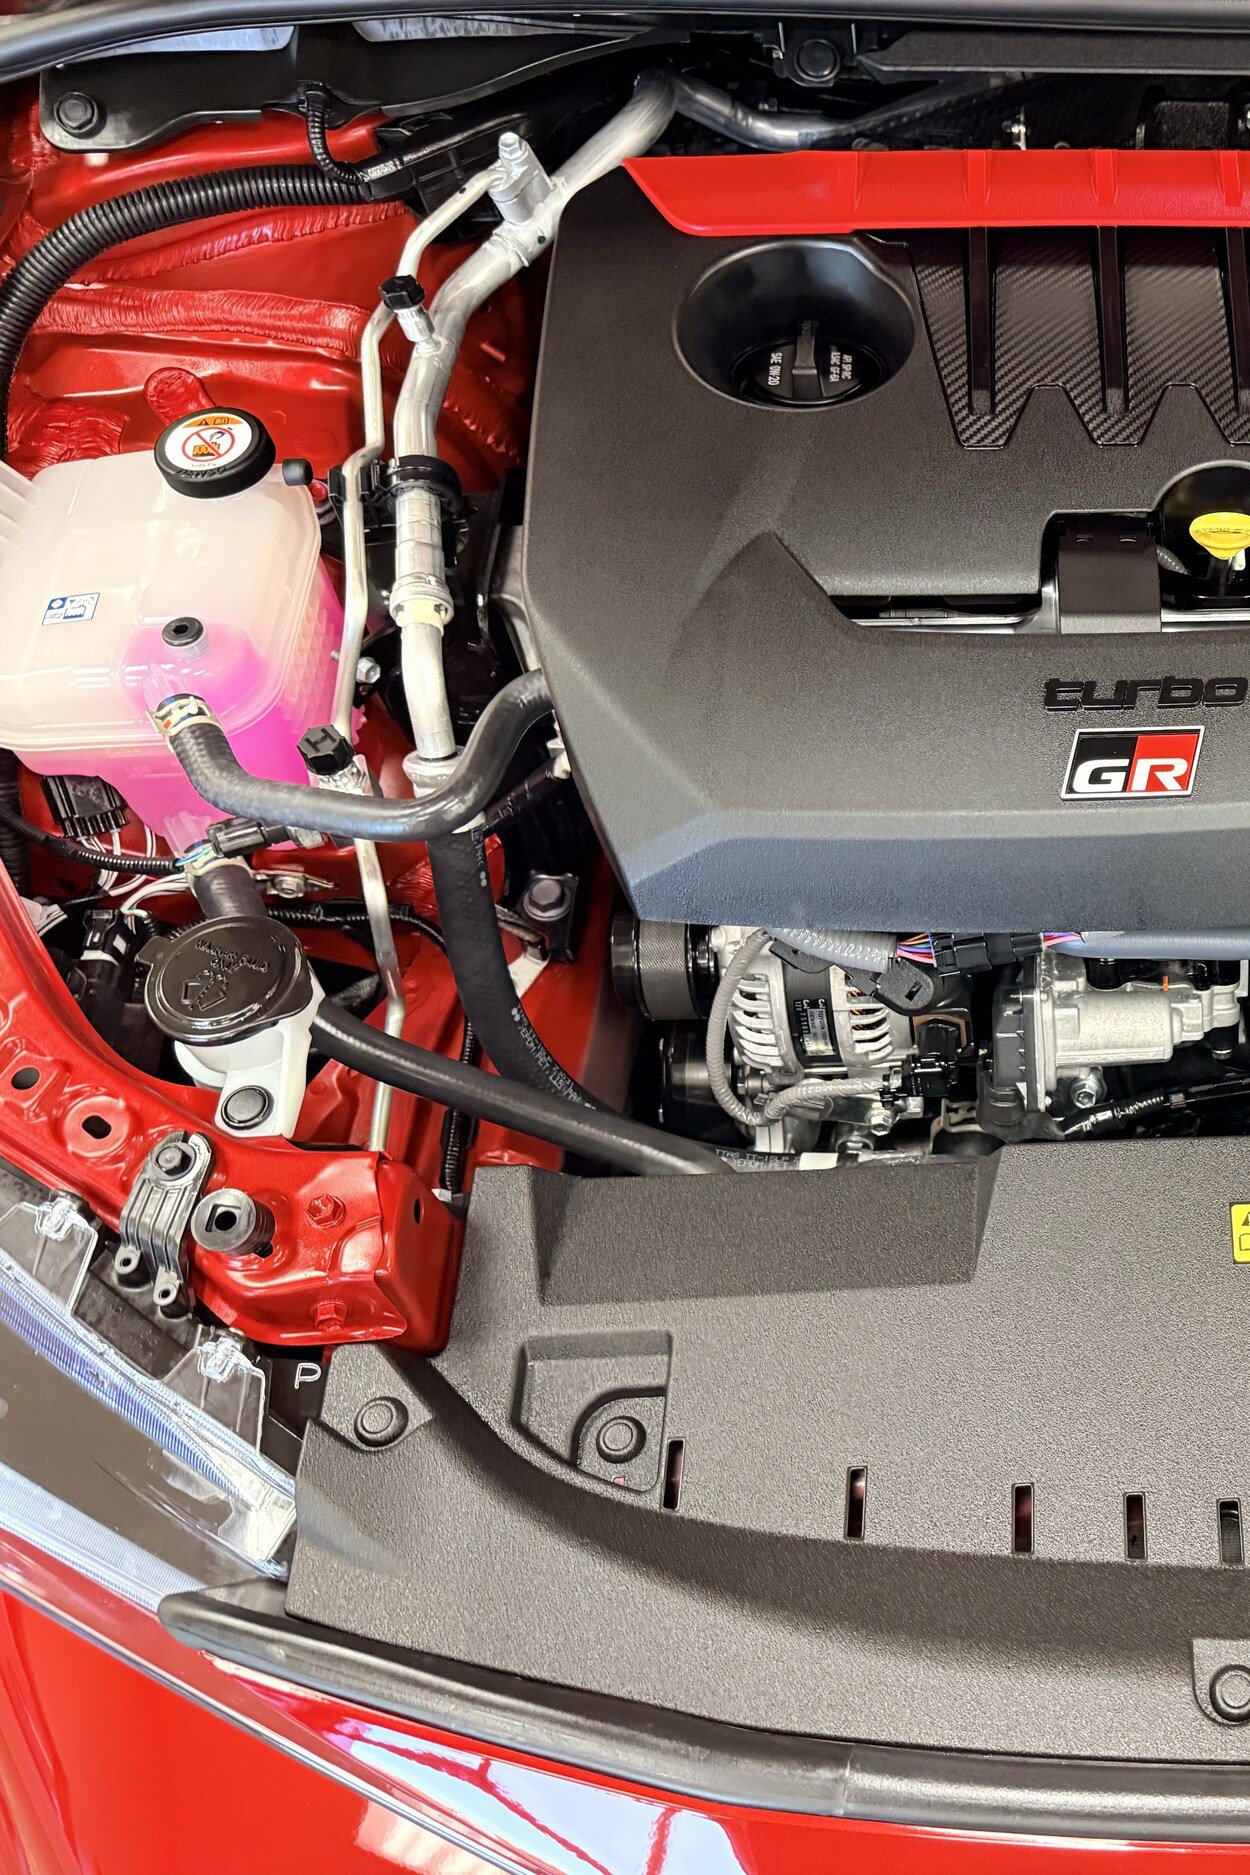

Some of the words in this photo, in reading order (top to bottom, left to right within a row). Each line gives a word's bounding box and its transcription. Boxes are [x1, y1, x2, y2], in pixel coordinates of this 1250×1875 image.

[770, 352, 783, 365] SAE
[767, 365, 782, 386] 0W-20
[1044, 675, 1249, 711] turbo
[304, 727, 337, 752] H
[1072, 757, 1189, 793] GR
[294, 1362, 322, 1390] P
